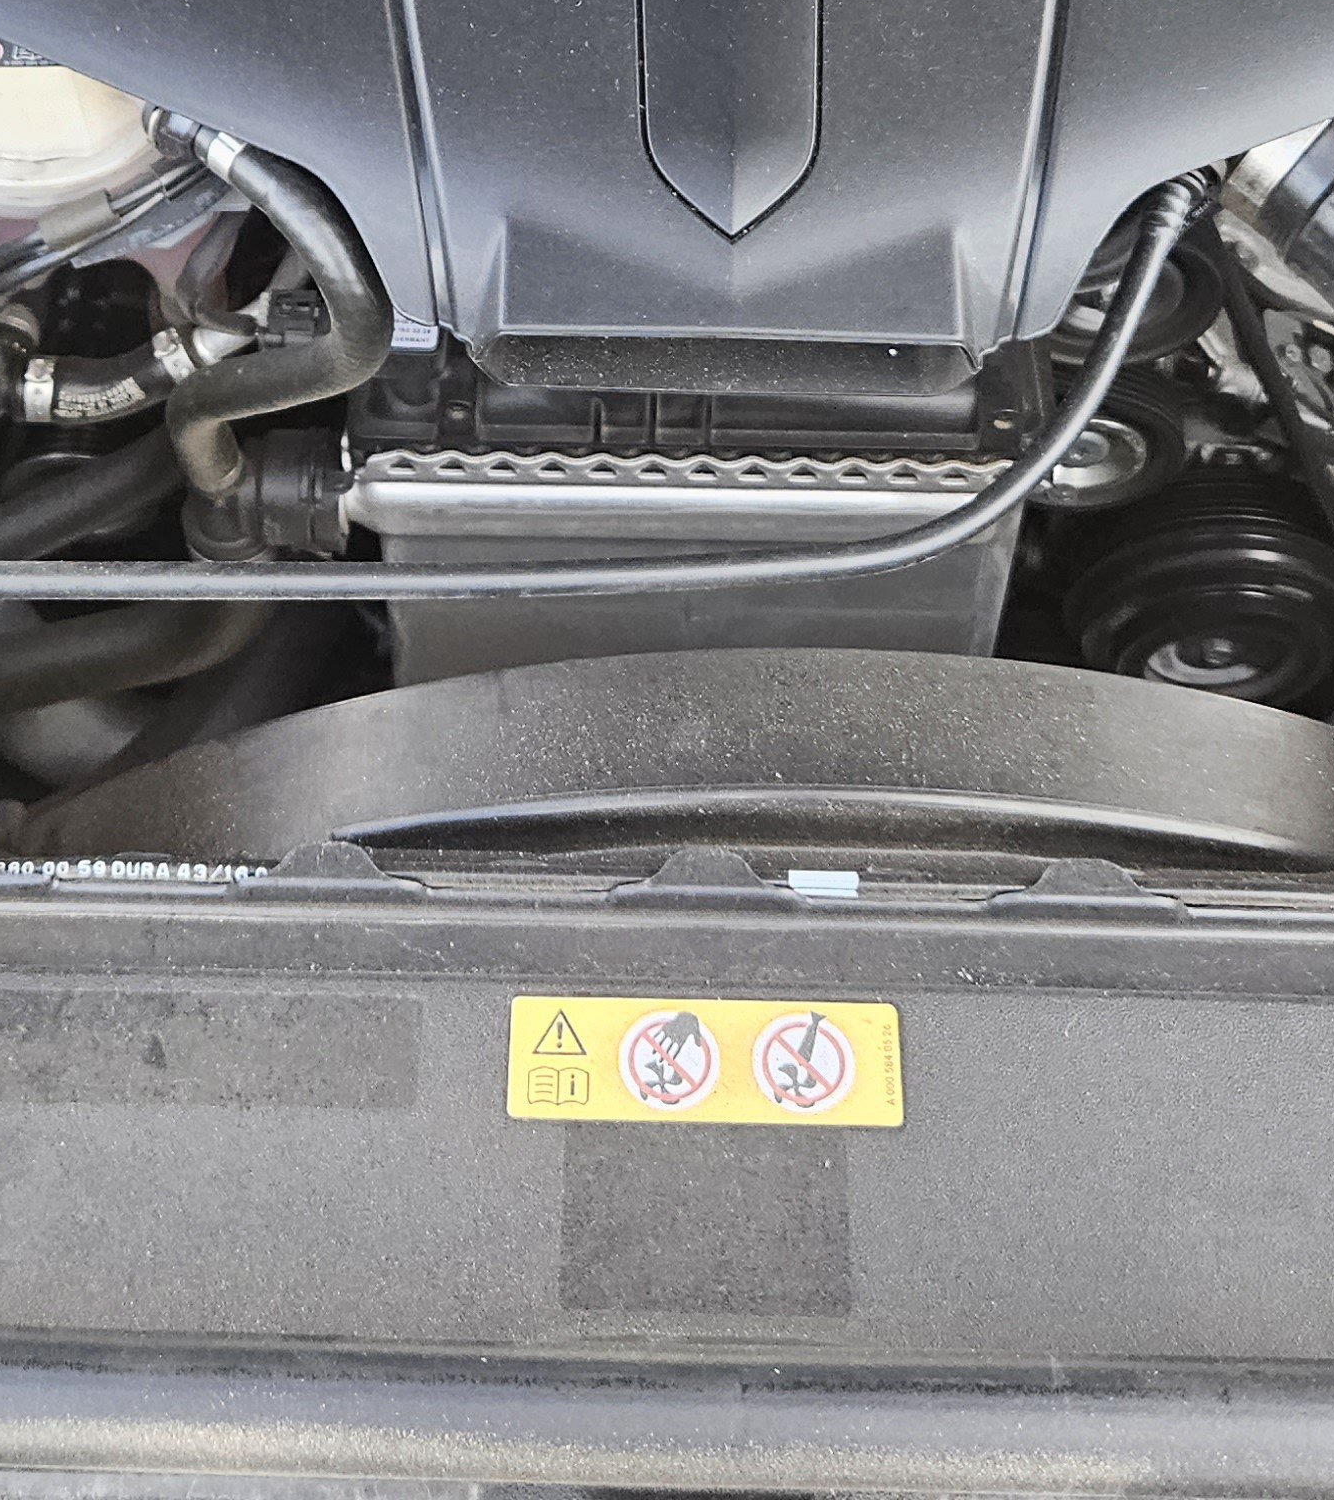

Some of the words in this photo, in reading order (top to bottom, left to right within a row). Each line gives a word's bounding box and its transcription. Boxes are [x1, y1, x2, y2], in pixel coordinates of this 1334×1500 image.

[111, 860, 170, 880] DURA
[884, 1055, 894, 1074] 584
[885, 1076, 895, 1096] 000
